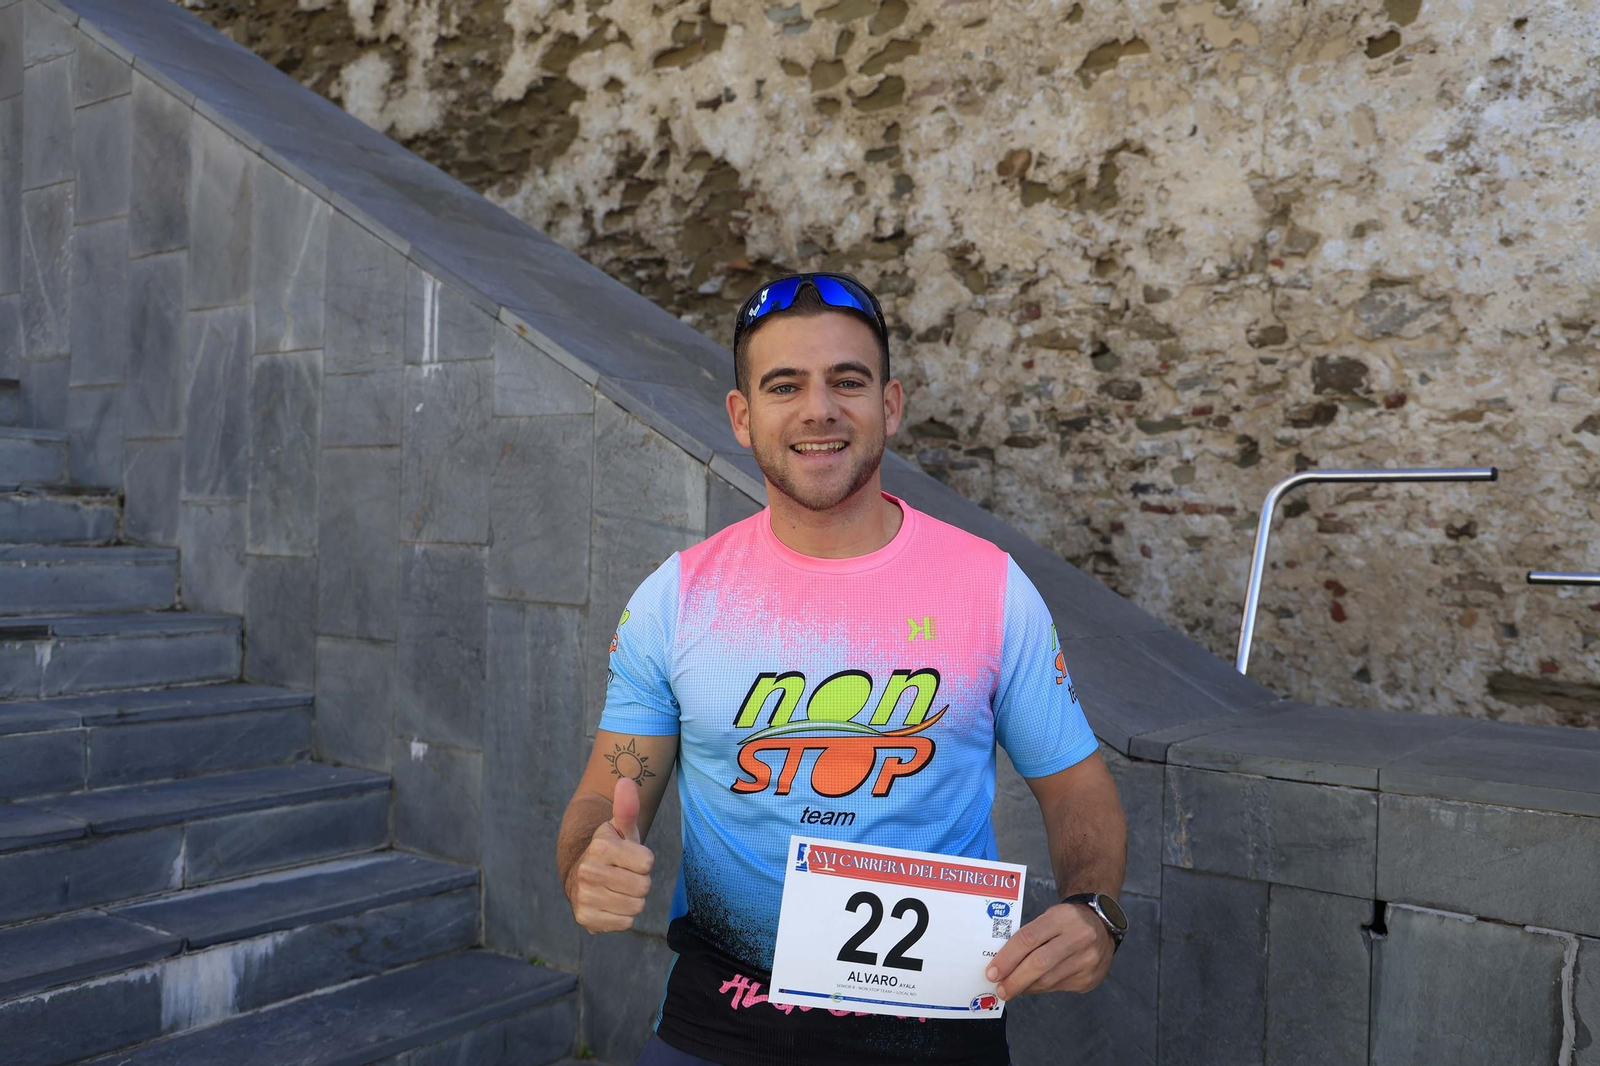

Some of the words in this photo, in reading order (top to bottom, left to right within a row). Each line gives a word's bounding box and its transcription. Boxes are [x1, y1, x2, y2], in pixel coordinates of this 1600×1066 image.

[730, 736, 936, 798] STOP
[800, 806, 856, 827] team
[812, 849, 837, 867] XVI
[839, 853, 907, 876] CARRERA
[909, 863, 938, 880] DEL
[940, 866, 1017, 890] ESTRECHO
[836, 890, 930, 972] 22
[847, 970, 898, 987] ALVARO
